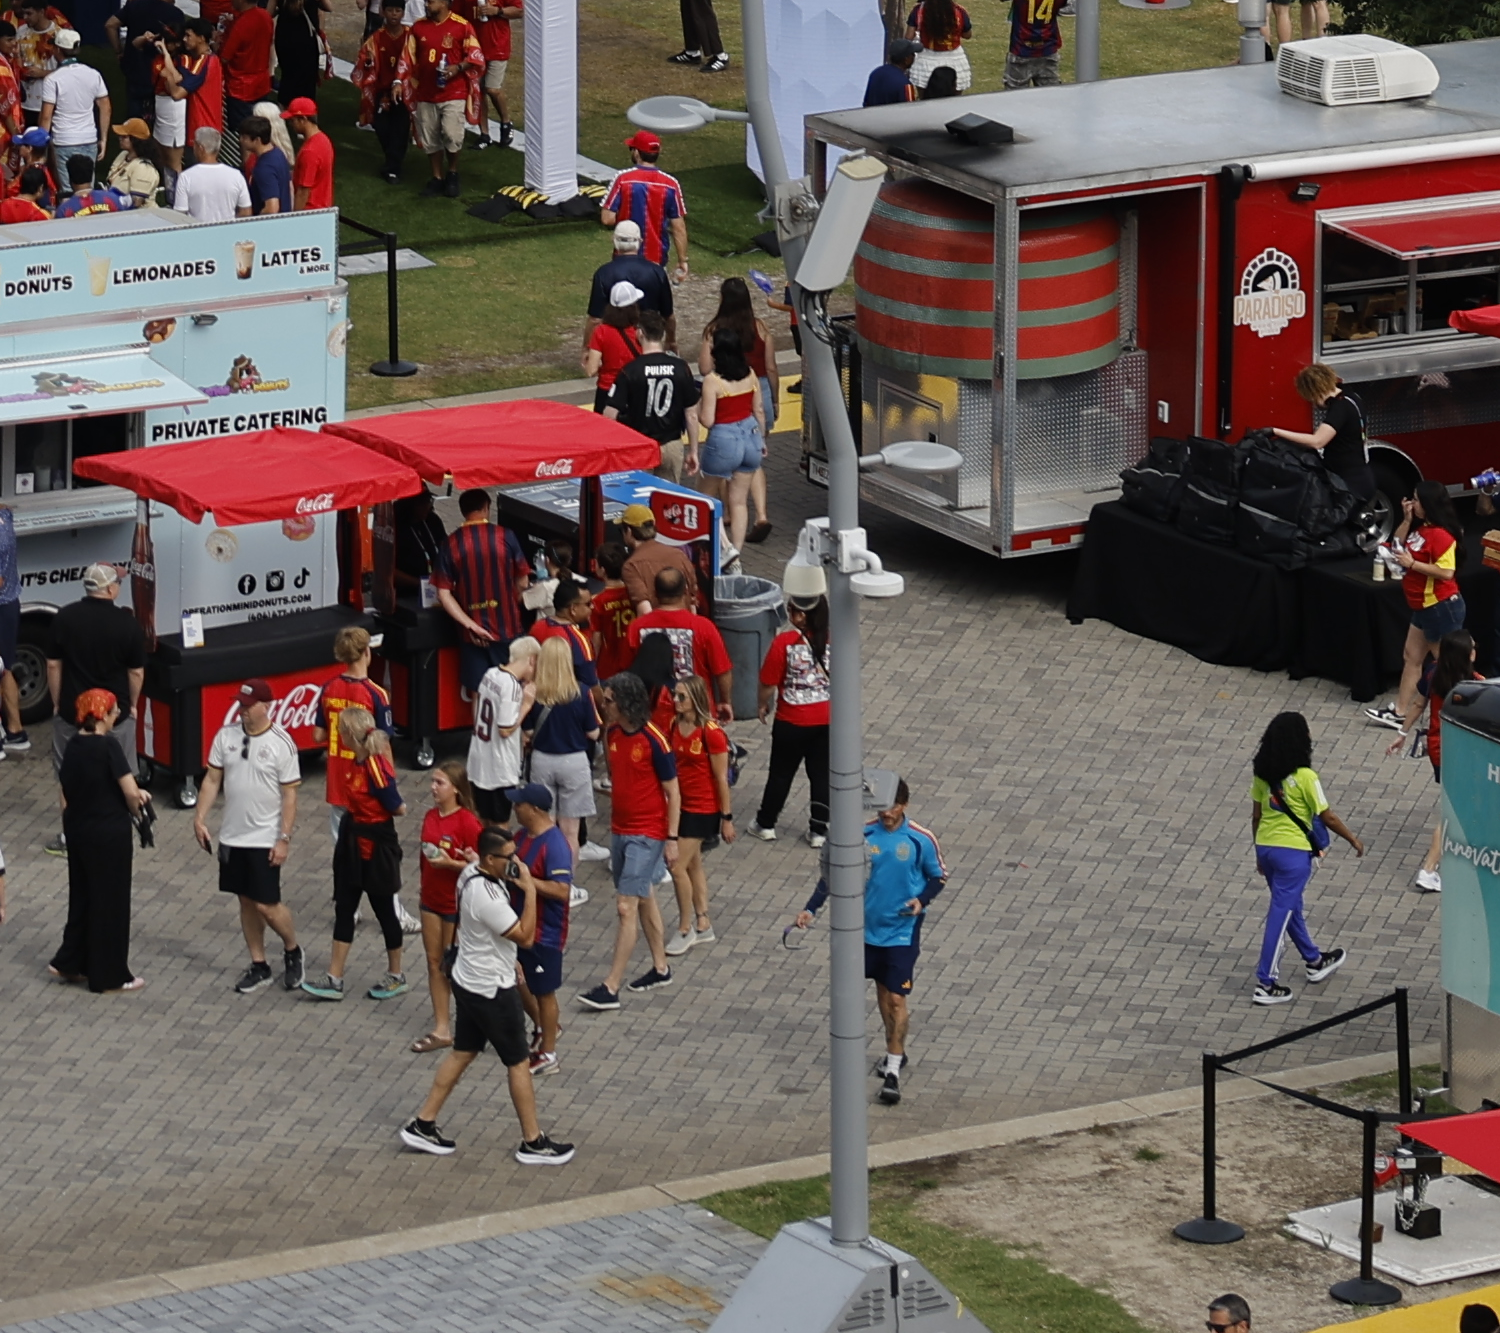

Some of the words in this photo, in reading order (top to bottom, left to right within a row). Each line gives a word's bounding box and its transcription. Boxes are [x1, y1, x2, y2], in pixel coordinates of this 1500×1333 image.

[260, 246, 322, 268] LATTES
[26, 264, 53, 276] MINI
[112, 260, 217, 286] LEMONADES
[4, 276, 74, 297] DONUTS
[1233, 288, 1306, 324] PARADISO
[644, 364, 675, 378] PULISIC
[646, 378, 674, 417] 10
[152, 415, 230, 442] PRIVATE
[233, 406, 328, 433] CATERING
[535, 457, 573, 478] Coca-Cola
[295, 492, 335, 514] Coca-Cola
